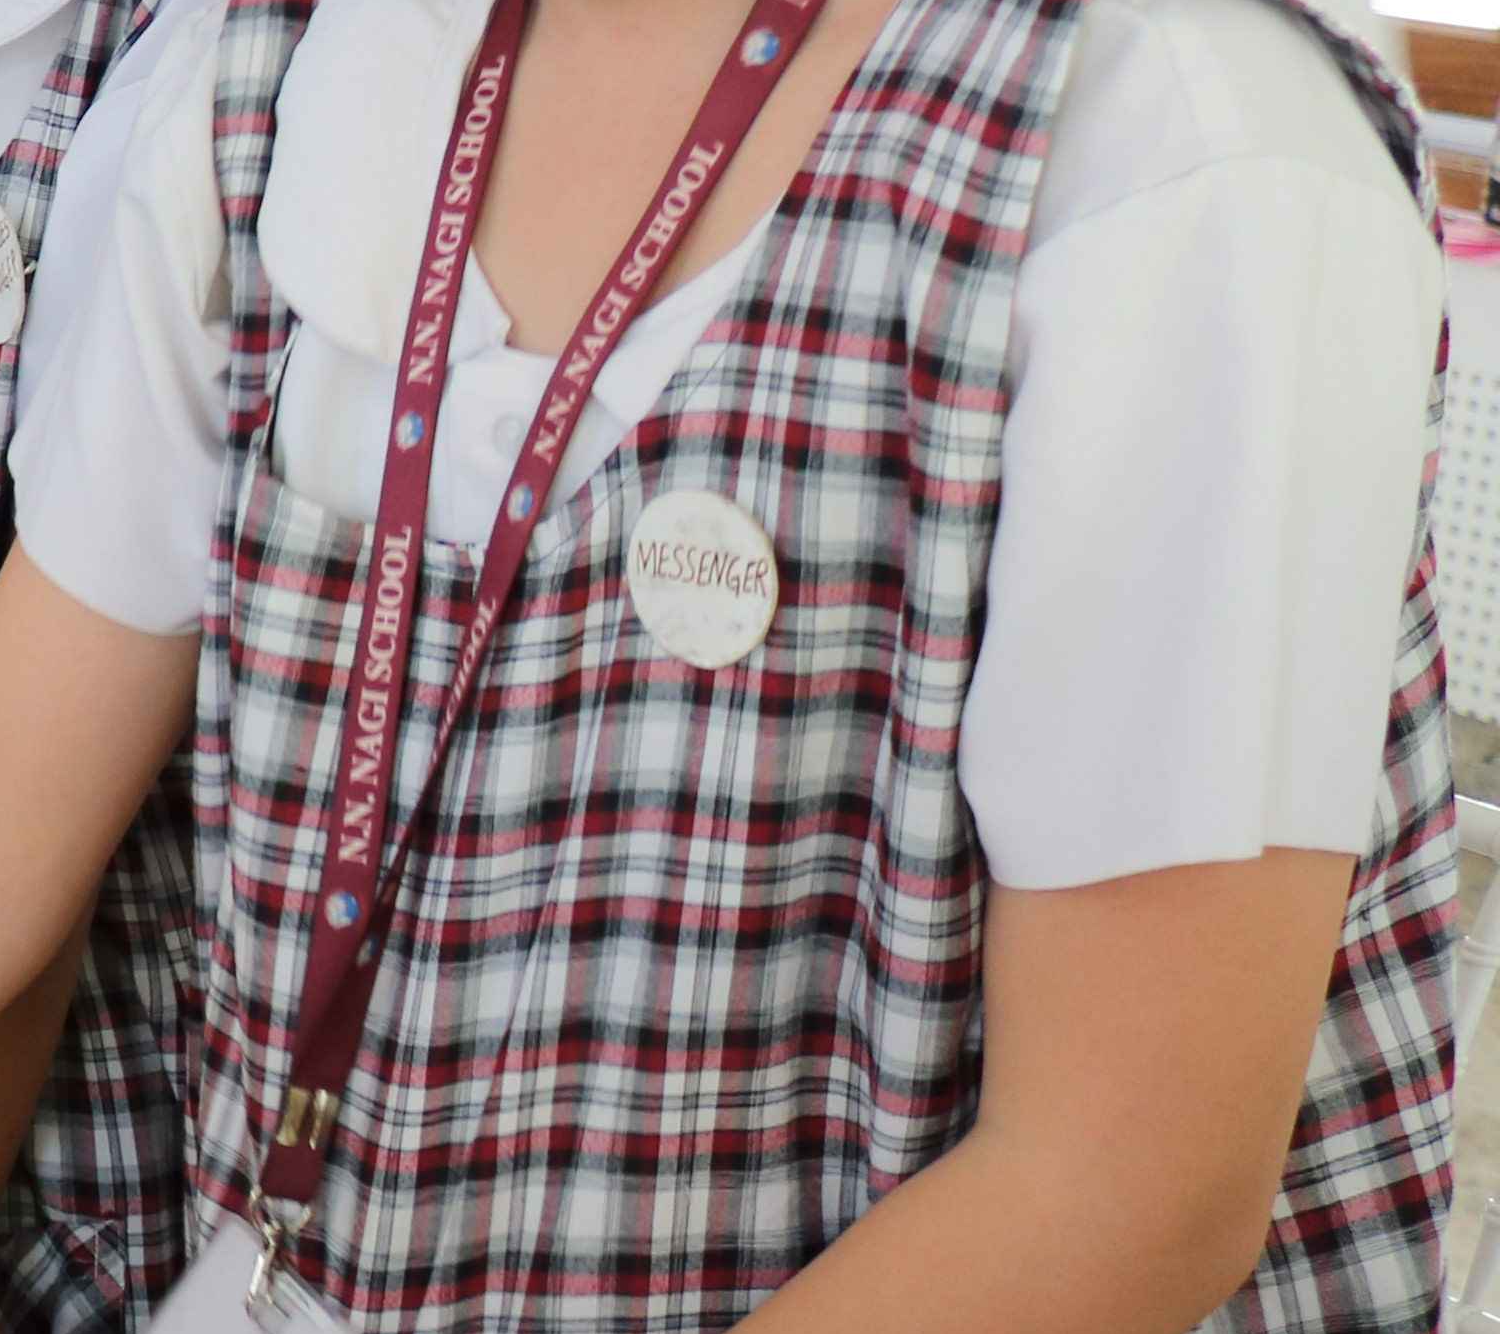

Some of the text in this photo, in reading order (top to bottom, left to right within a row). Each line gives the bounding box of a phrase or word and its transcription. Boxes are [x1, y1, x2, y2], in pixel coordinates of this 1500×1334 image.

[408, 54, 506, 386] N.N. NAGI SCHOOL
[532, 139, 724, 465] N.N. NAGI SCHOOL
[338, 525, 412, 866] N.N. NAGI SCHOOL
[636, 540, 769, 598] MESSENGER
